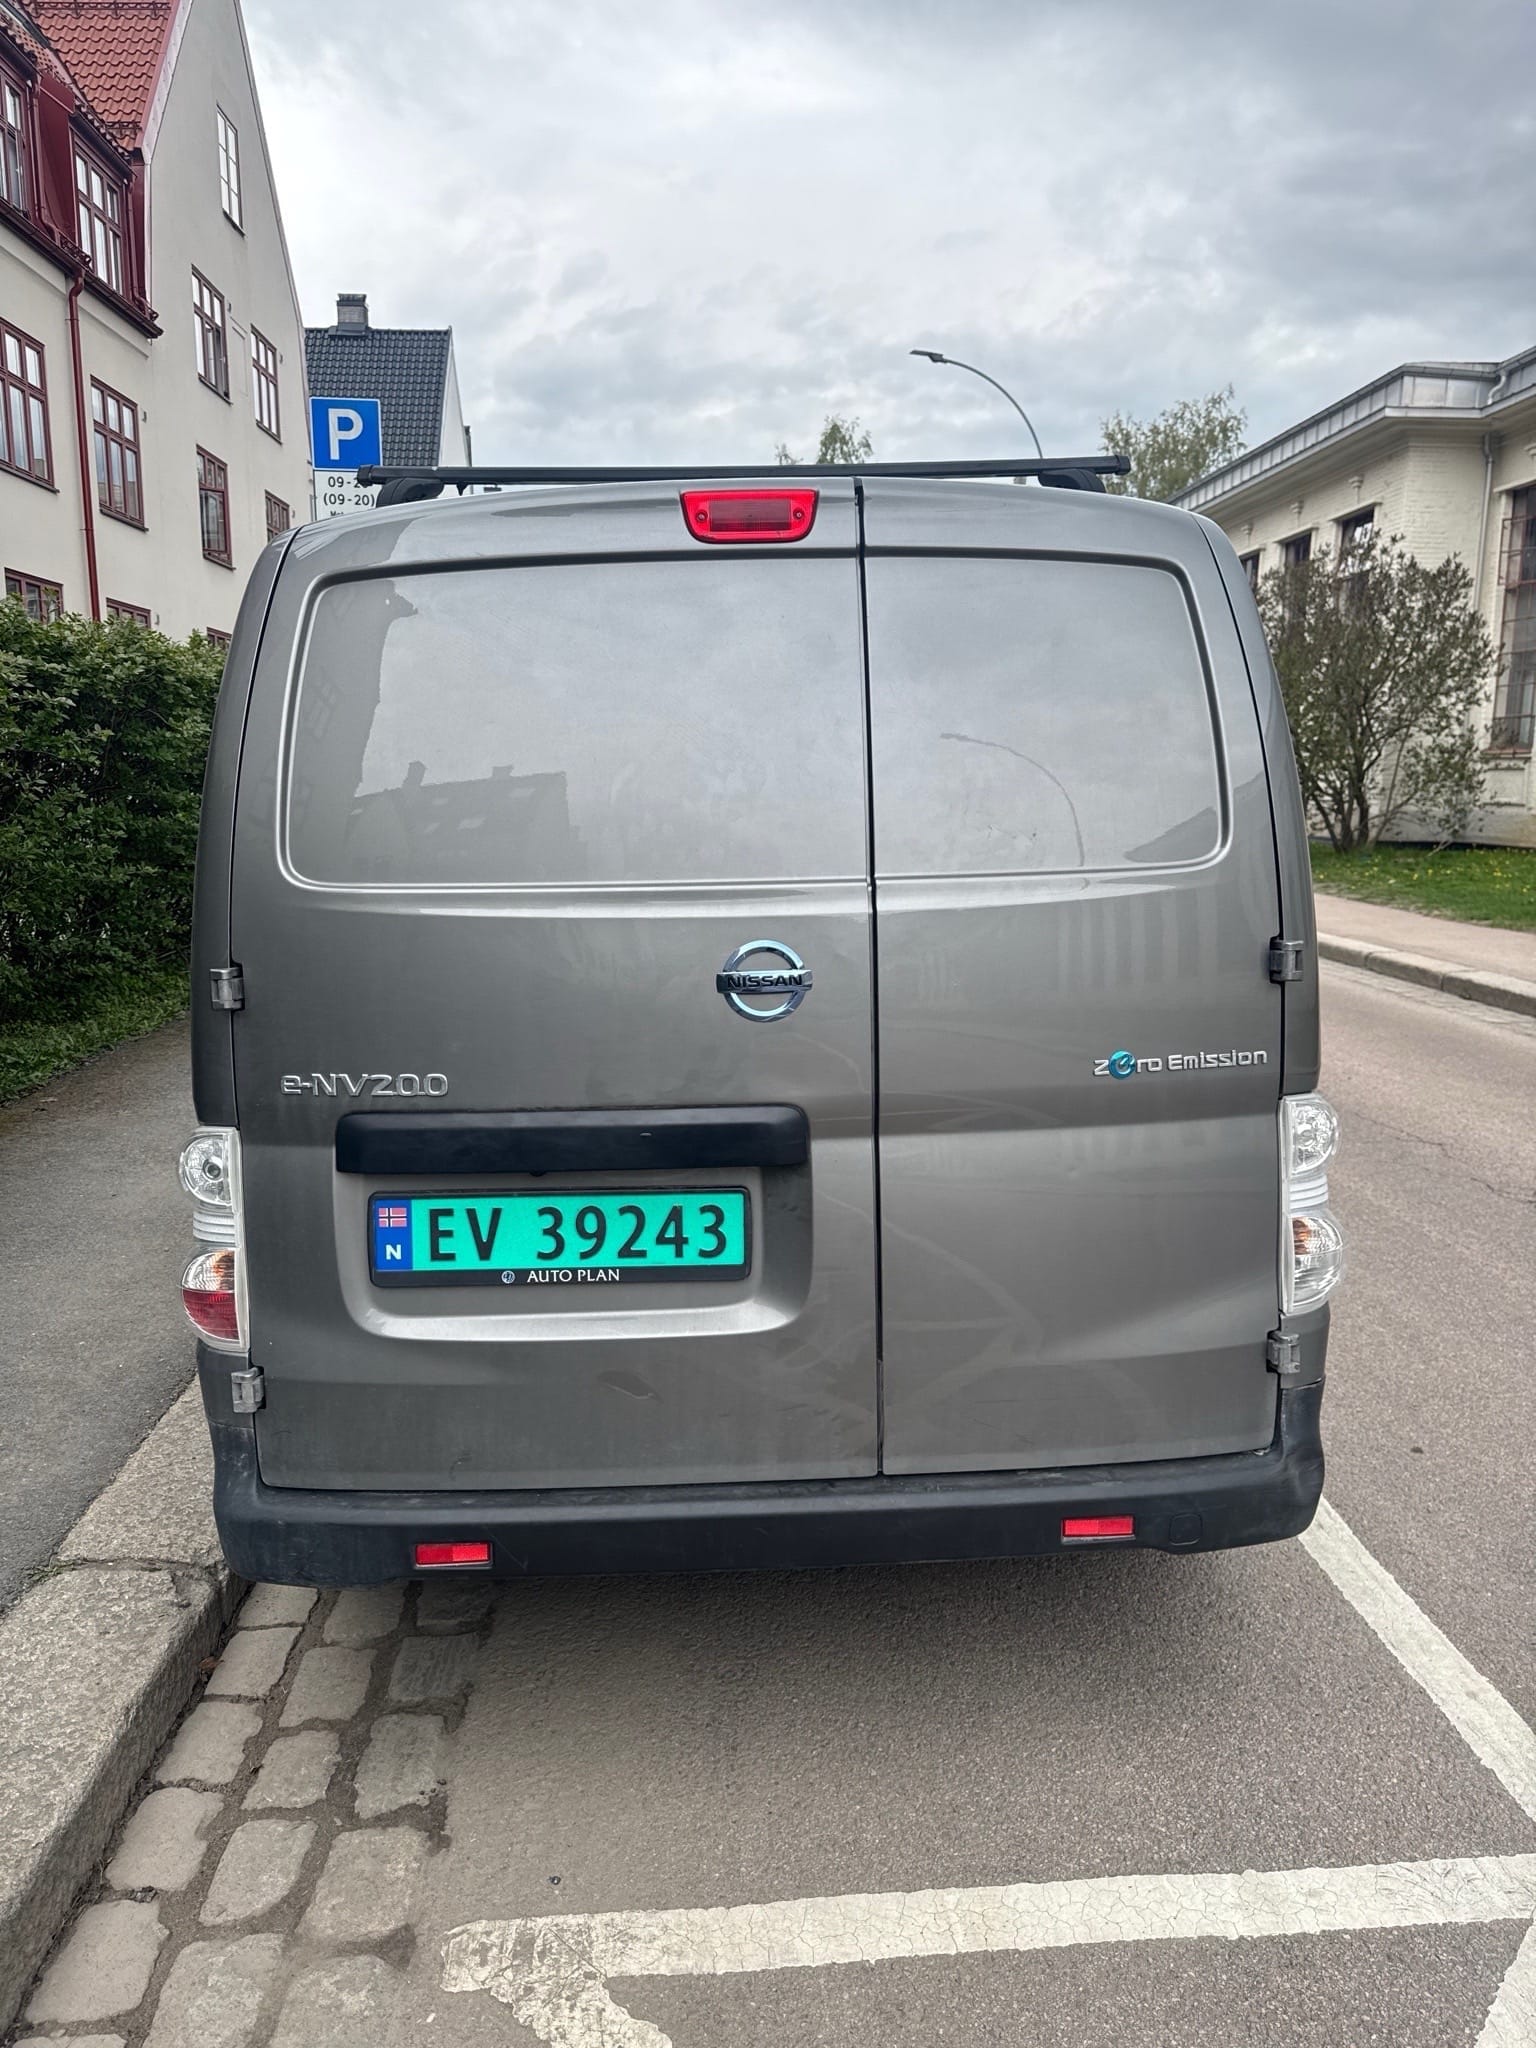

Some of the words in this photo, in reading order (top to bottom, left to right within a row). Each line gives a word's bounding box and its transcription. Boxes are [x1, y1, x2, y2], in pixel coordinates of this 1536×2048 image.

[328, 408, 363, 460] P
[727, 973, 803, 988] NISSAN
[1167, 1049, 1268, 1070] Emission
[281, 1073, 448, 1096] e-NV200
[429, 1207, 502, 1262] EV
[536, 1204, 727, 1260] 39243
[385, 1244, 402, 1260] N
[527, 1269, 573, 1283] AUTO
[577, 1268, 620, 1282] PLAN
